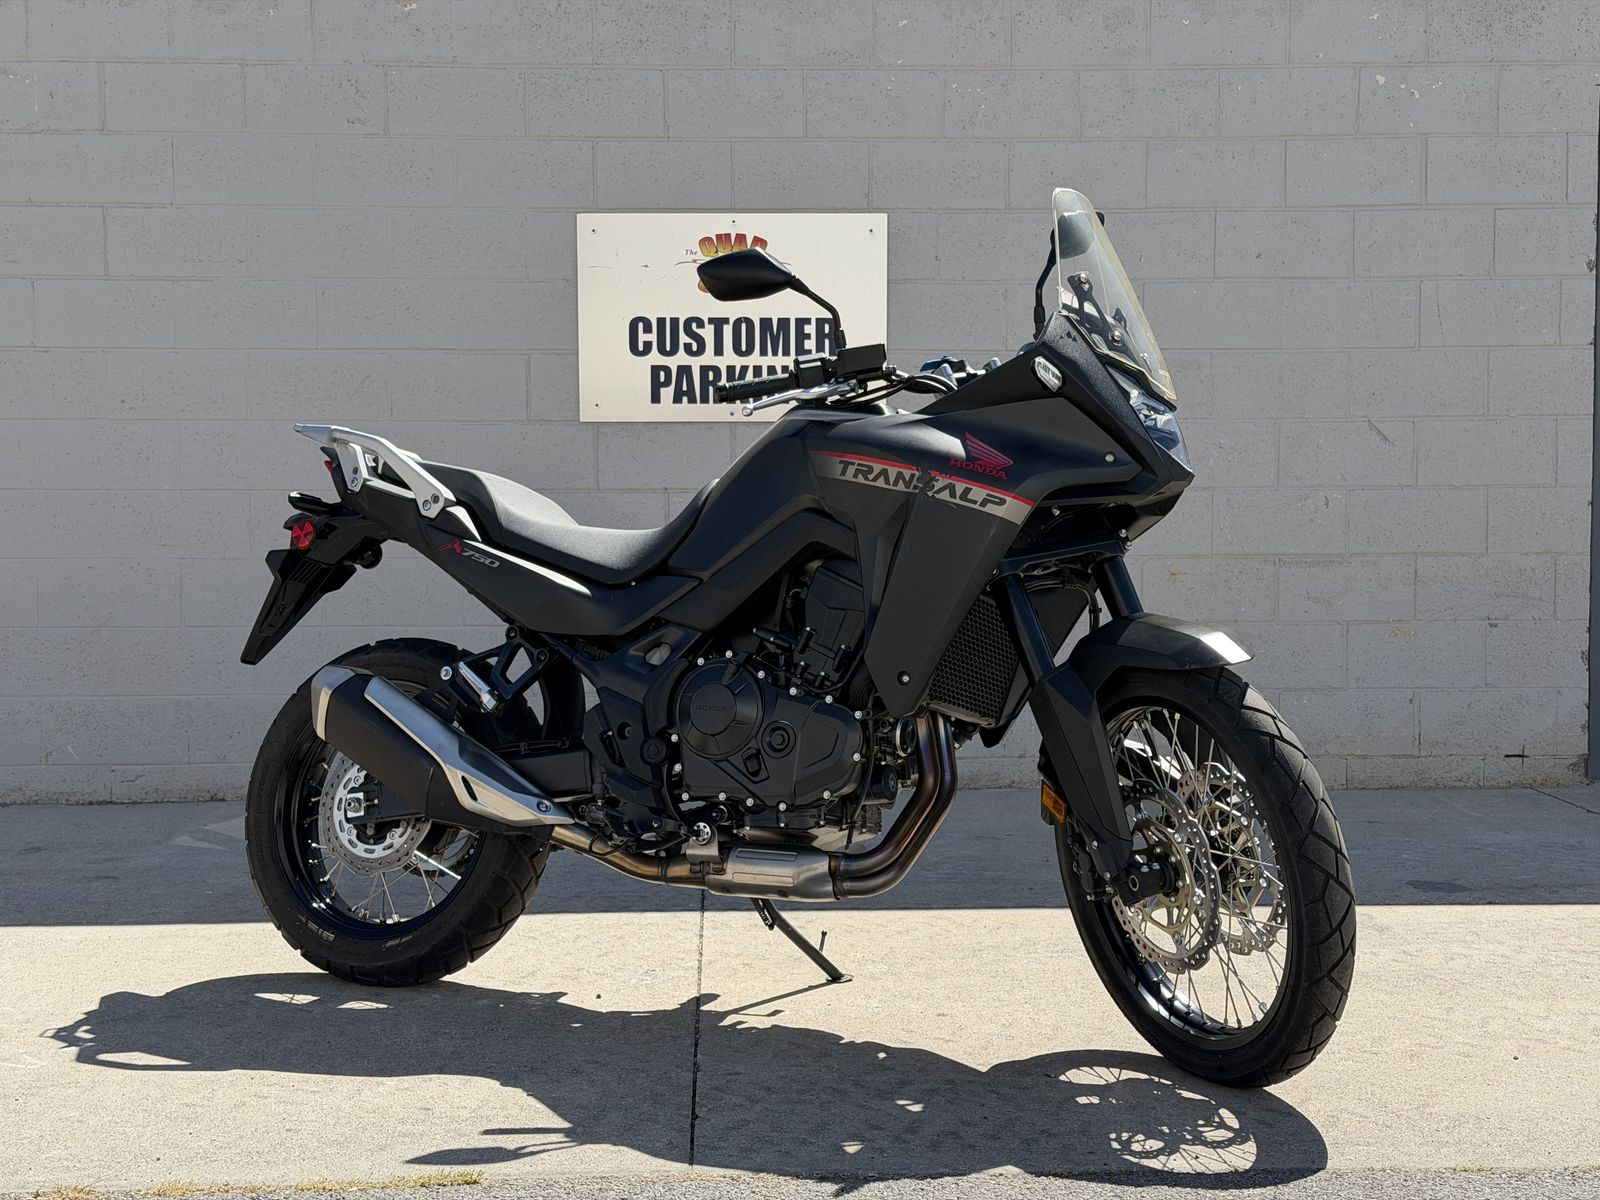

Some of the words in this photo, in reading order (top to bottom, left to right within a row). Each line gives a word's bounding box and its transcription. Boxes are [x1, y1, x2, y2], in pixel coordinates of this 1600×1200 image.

[684, 248, 698, 256] The
[628, 315, 838, 358] CUSTOMER
[650, 364, 790, 405] PARKI
[950, 458, 1008, 480] HONDA
[838, 459, 1007, 508] TRANSALP
[461, 548, 500, 568] 750
[695, 703, 729, 713] HONDA
